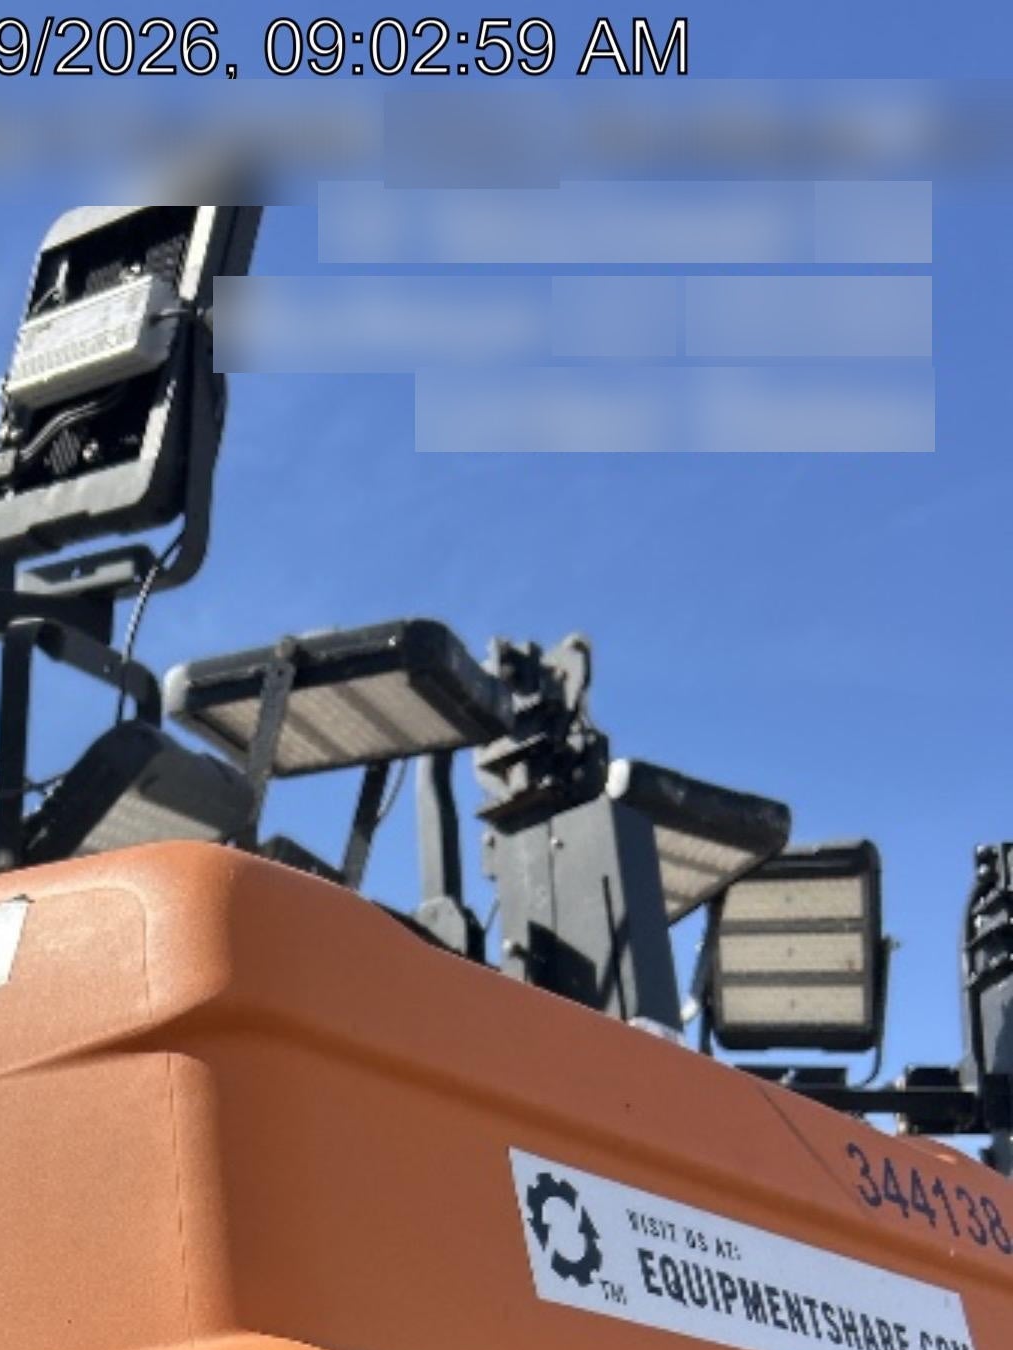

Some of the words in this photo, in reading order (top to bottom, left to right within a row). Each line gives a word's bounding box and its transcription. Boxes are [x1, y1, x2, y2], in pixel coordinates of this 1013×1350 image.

[626, 1208, 676, 1242] VISIT
[684, 1226, 708, 1252] US
[846, 1142, 1013, 1254] 344138
